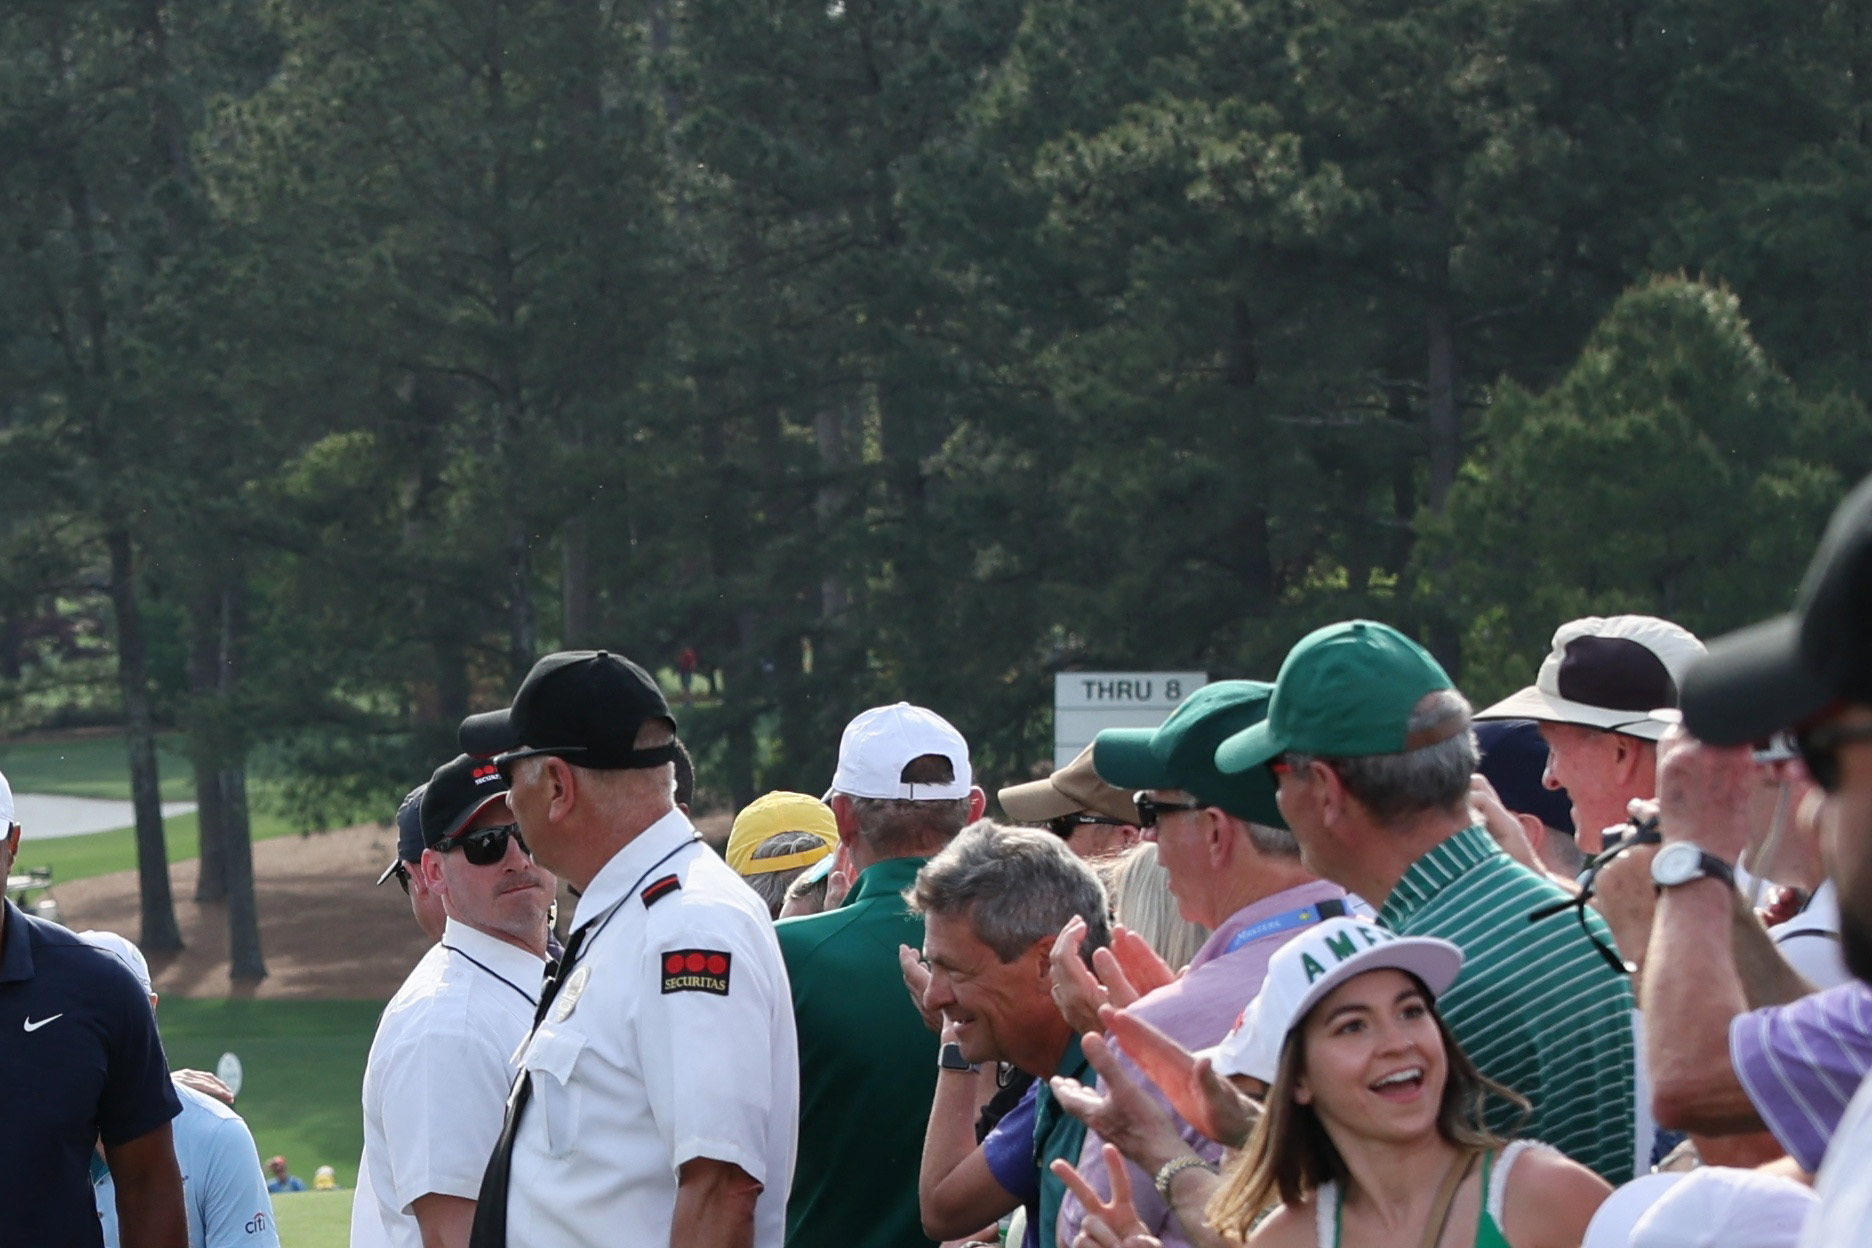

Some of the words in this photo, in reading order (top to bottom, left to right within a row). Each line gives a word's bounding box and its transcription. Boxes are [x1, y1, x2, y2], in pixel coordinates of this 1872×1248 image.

[1082, 679, 1152, 701] THRU
[1165, 679, 1181, 700] 8
[664, 976, 726, 991] SECURITAS
[245, 1215, 266, 1235] citi
